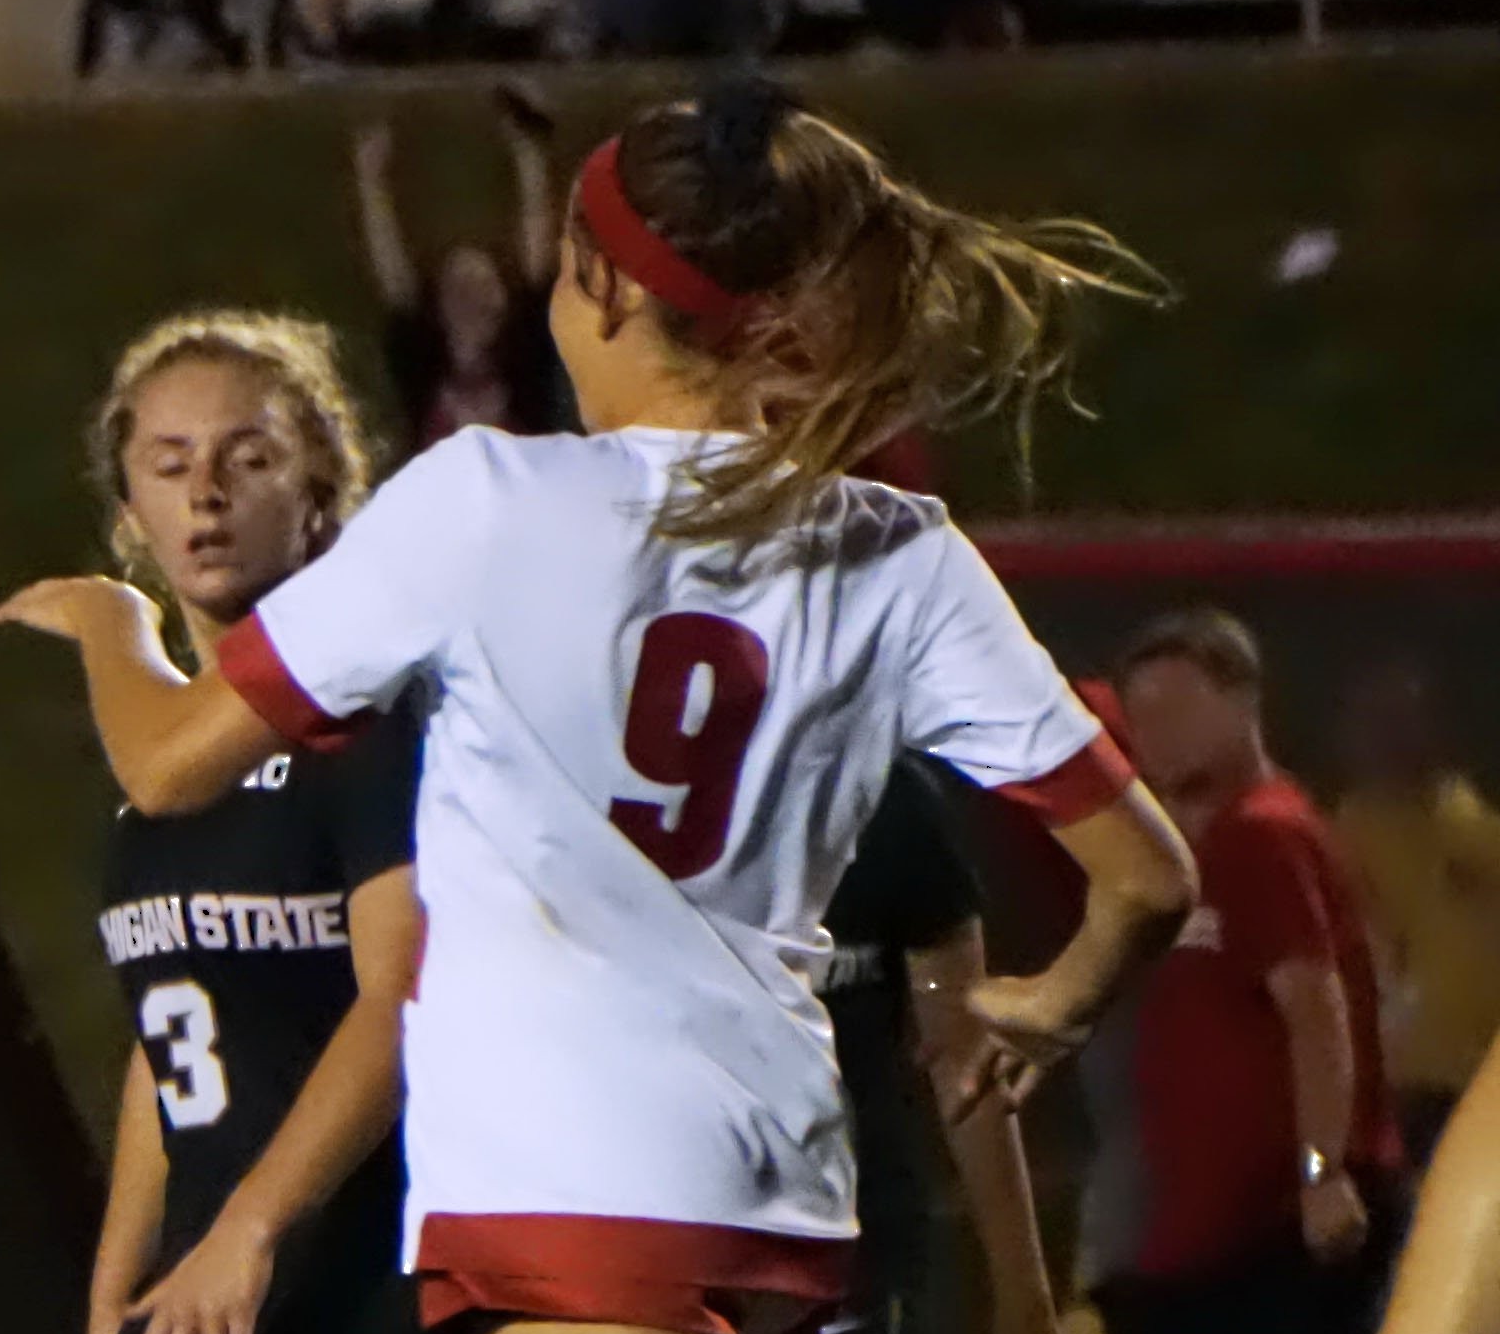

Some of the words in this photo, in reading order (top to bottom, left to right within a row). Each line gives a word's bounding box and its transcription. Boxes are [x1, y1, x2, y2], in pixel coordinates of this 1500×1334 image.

[608, 611, 769, 881] 9
[189, 893, 349, 951] STATE
[141, 980, 229, 1131] 3
